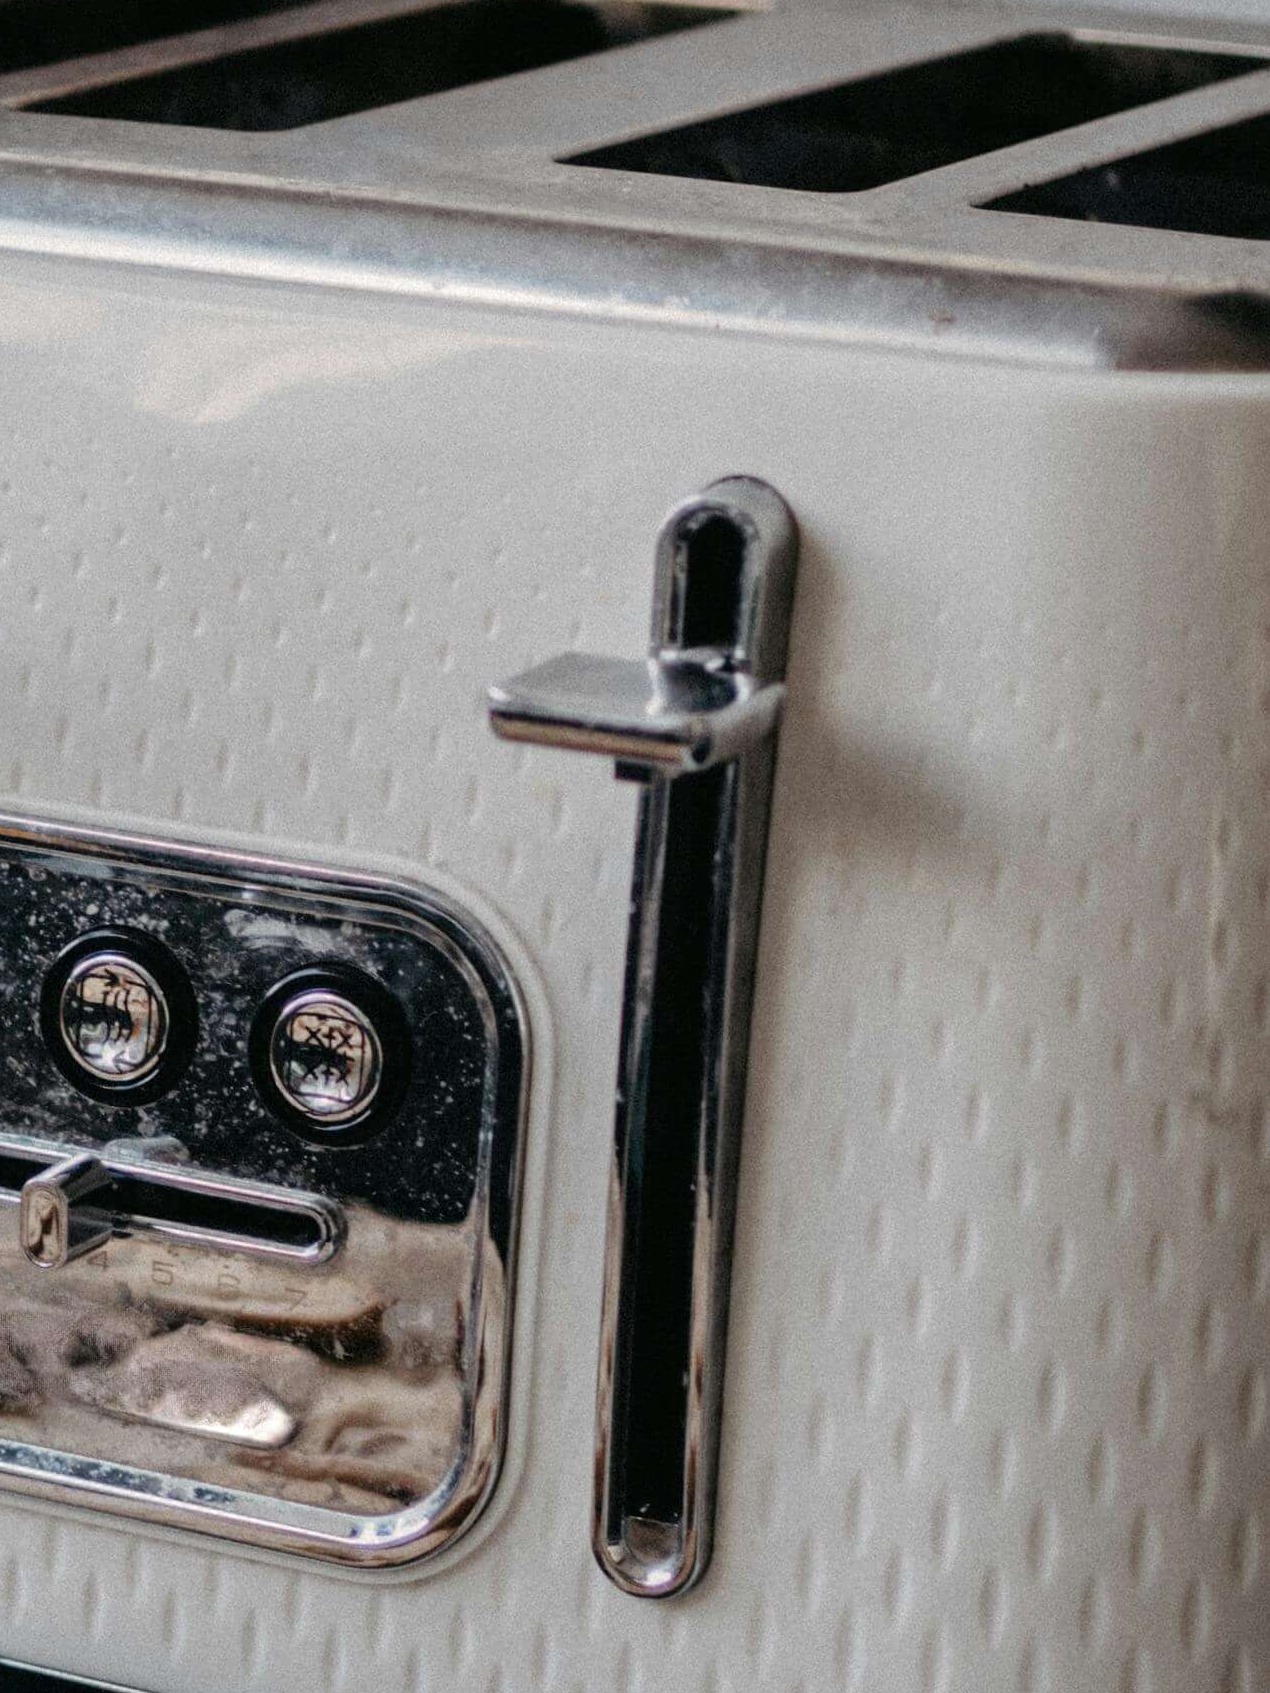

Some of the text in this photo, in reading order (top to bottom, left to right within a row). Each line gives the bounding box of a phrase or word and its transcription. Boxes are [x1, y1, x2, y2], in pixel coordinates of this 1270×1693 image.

[87, 1251, 109, 1271] 4
[151, 1260, 175, 1287] 5
[217, 1273, 242, 1300] 6
[284, 1286, 308, 1311] 7
